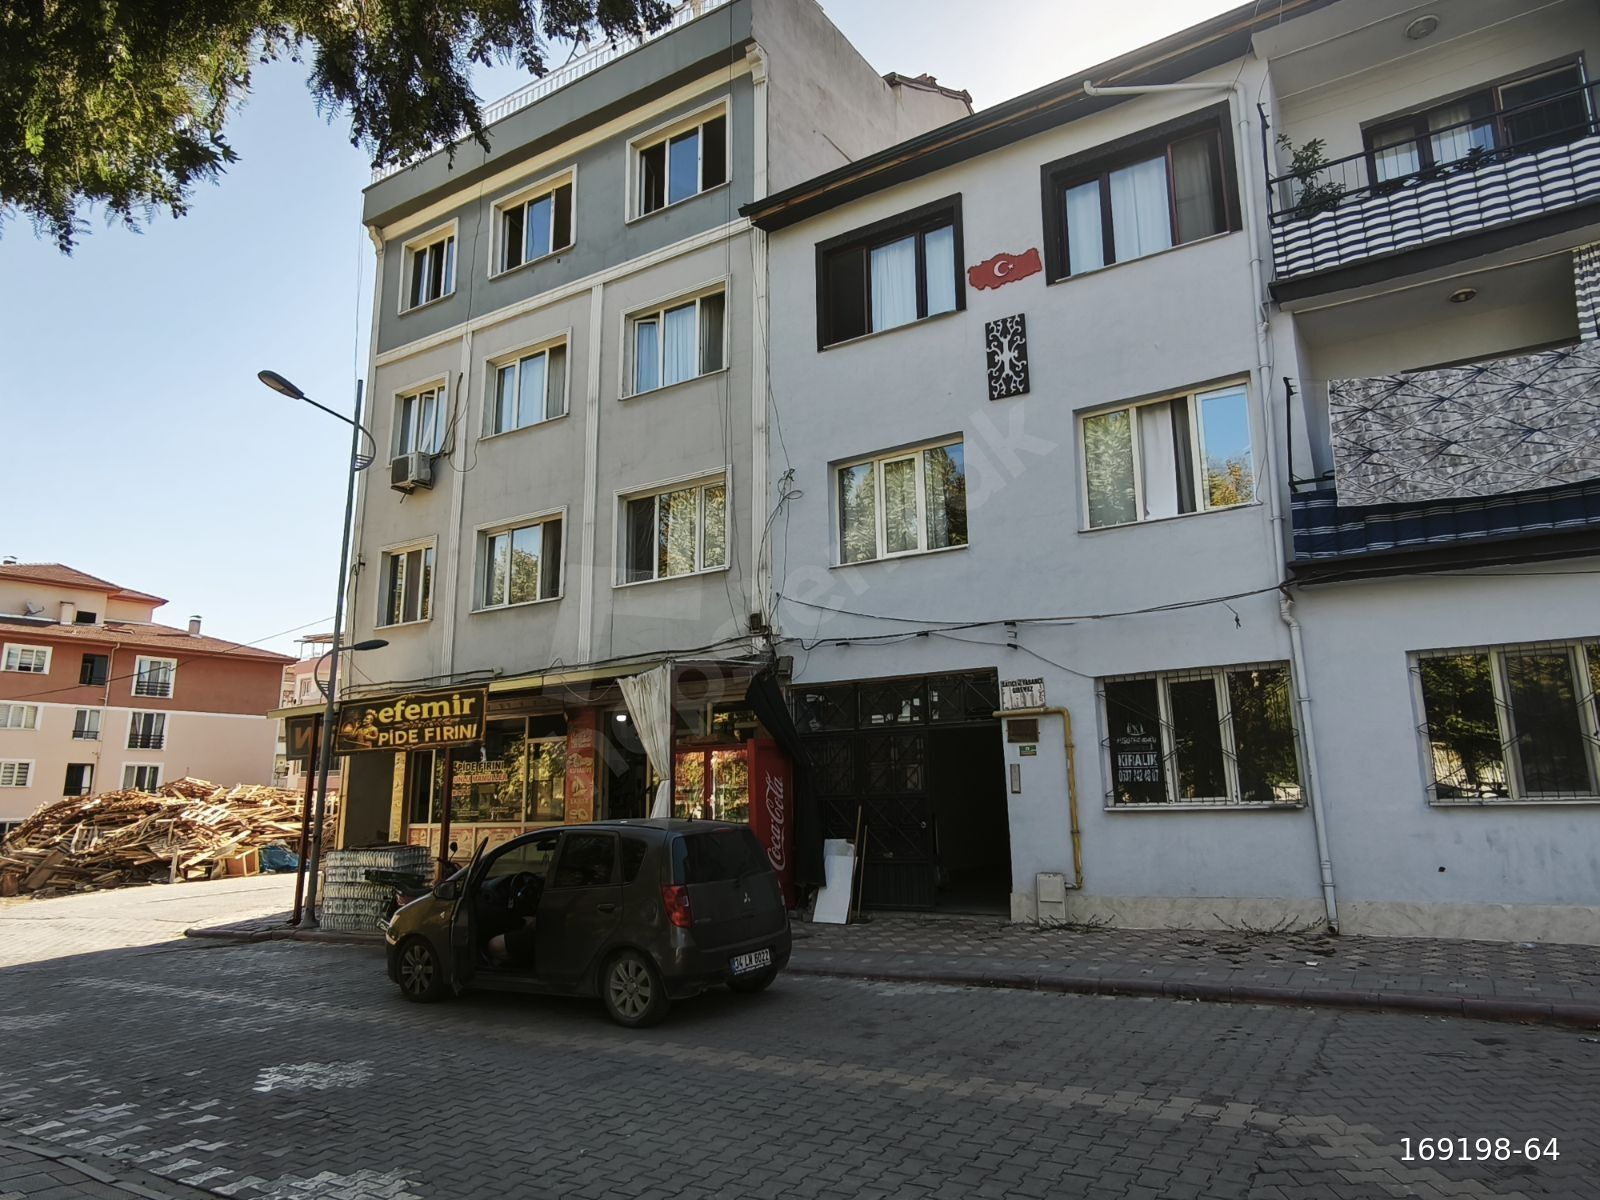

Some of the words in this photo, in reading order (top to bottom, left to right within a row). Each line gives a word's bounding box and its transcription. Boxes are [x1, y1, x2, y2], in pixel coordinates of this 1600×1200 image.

[379, 694, 476, 724] efemir
[378, 729, 419, 746] PİDE
[424, 723, 478, 742] FIRINI
[478, 760, 504, 772] FIRINI
[1118, 754, 1158, 766] KIRALIK
[765, 769, 786, 871] Coca-Cola
